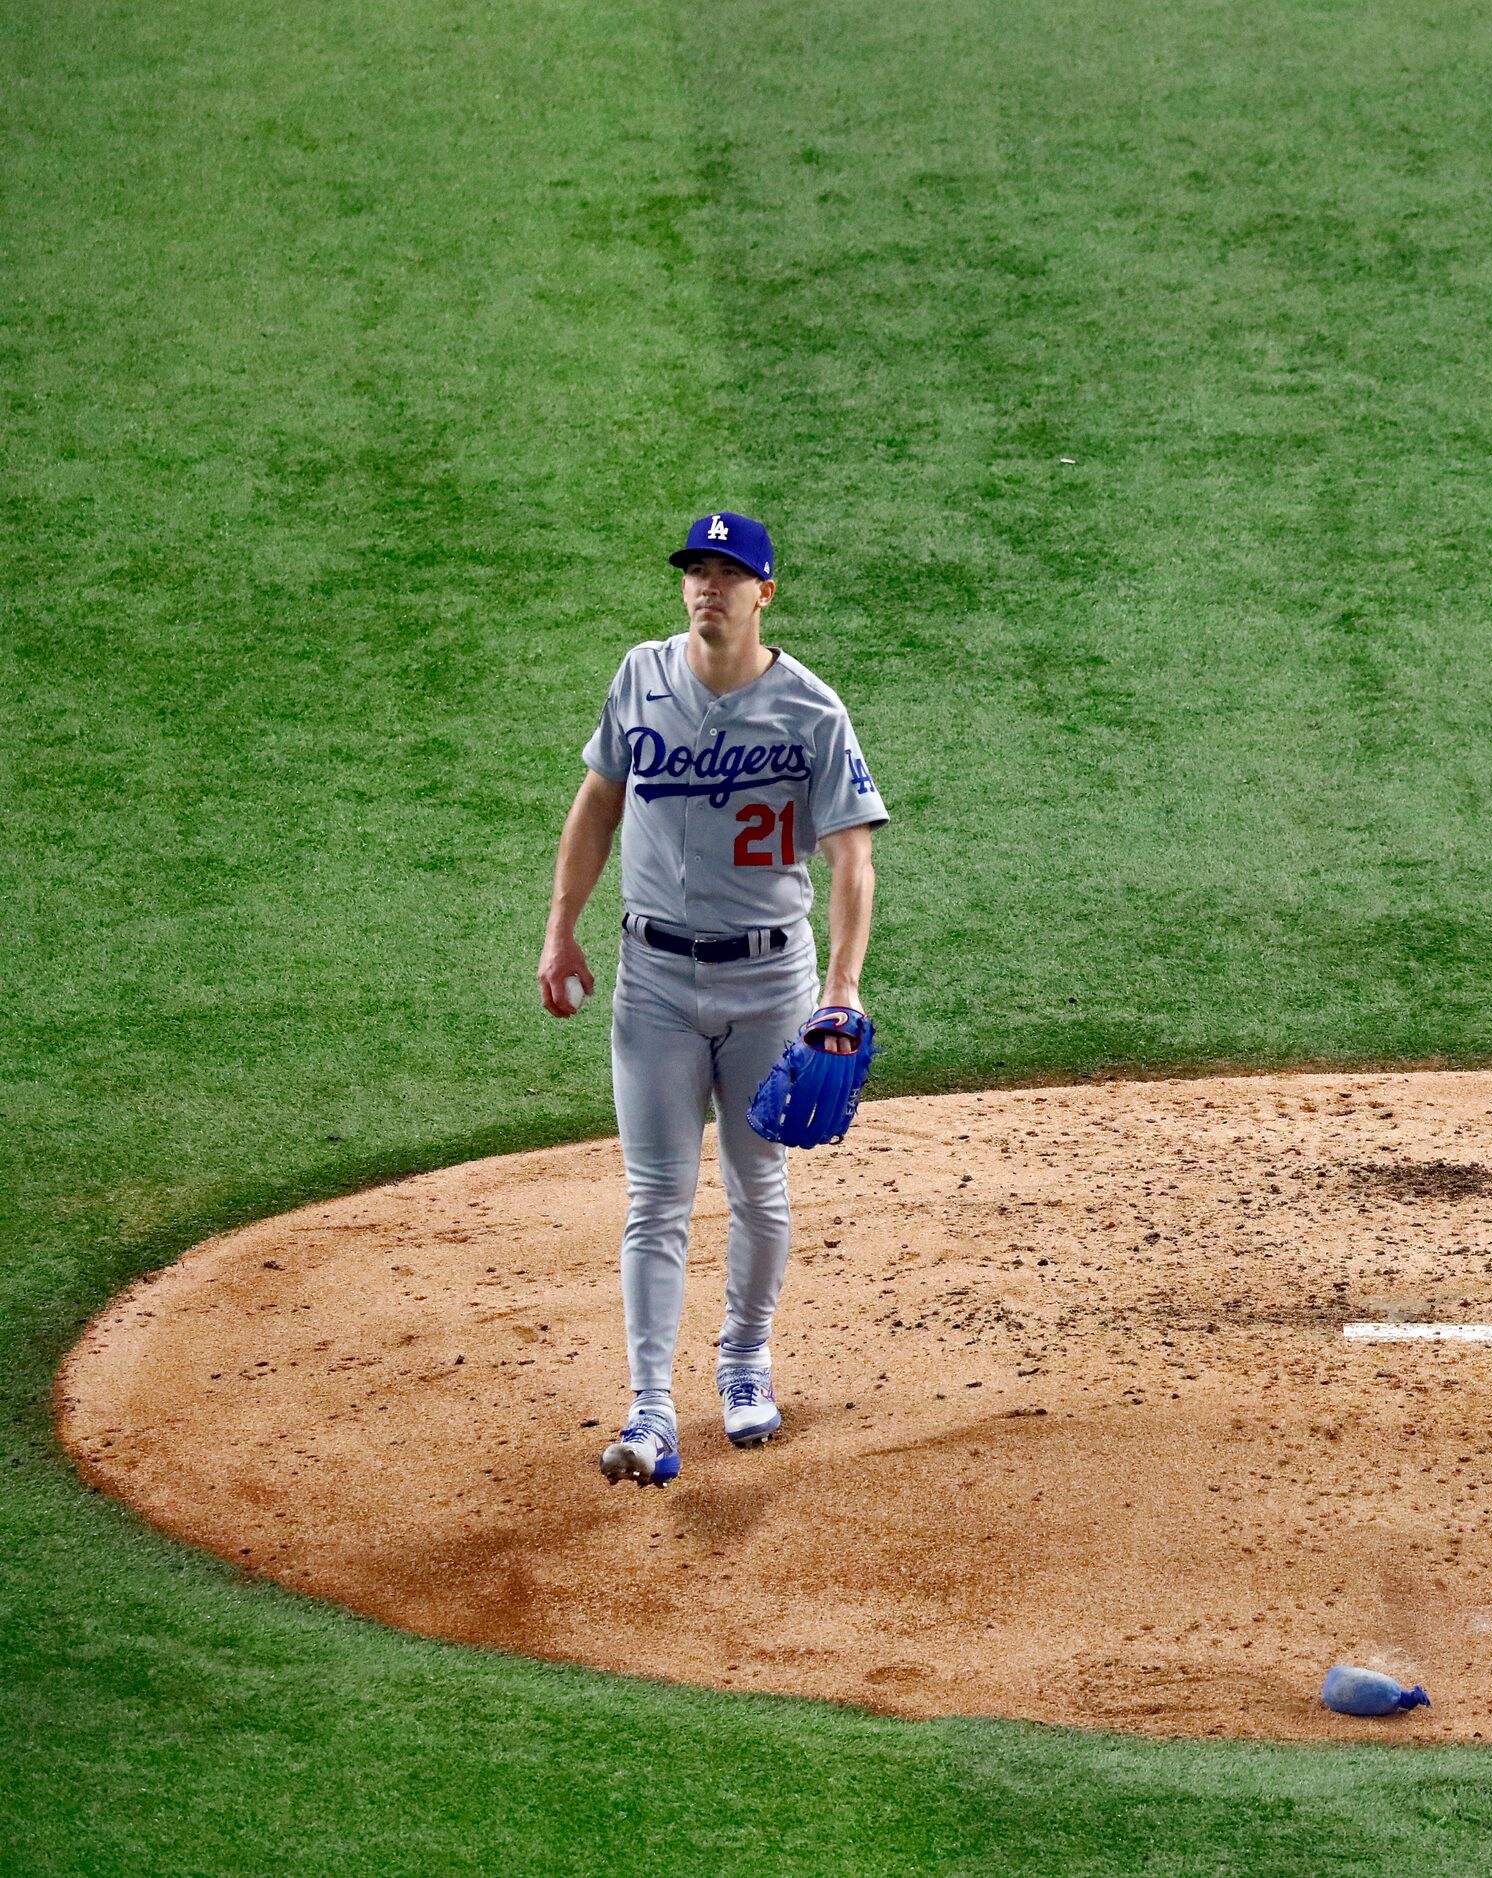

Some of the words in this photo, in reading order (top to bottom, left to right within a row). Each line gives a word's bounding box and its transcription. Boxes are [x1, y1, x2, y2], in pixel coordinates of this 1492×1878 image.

[708, 515, 728, 540] LA
[625, 726, 812, 809] Dodgers
[845, 749, 875, 794] LA
[733, 800, 795, 867] 21
